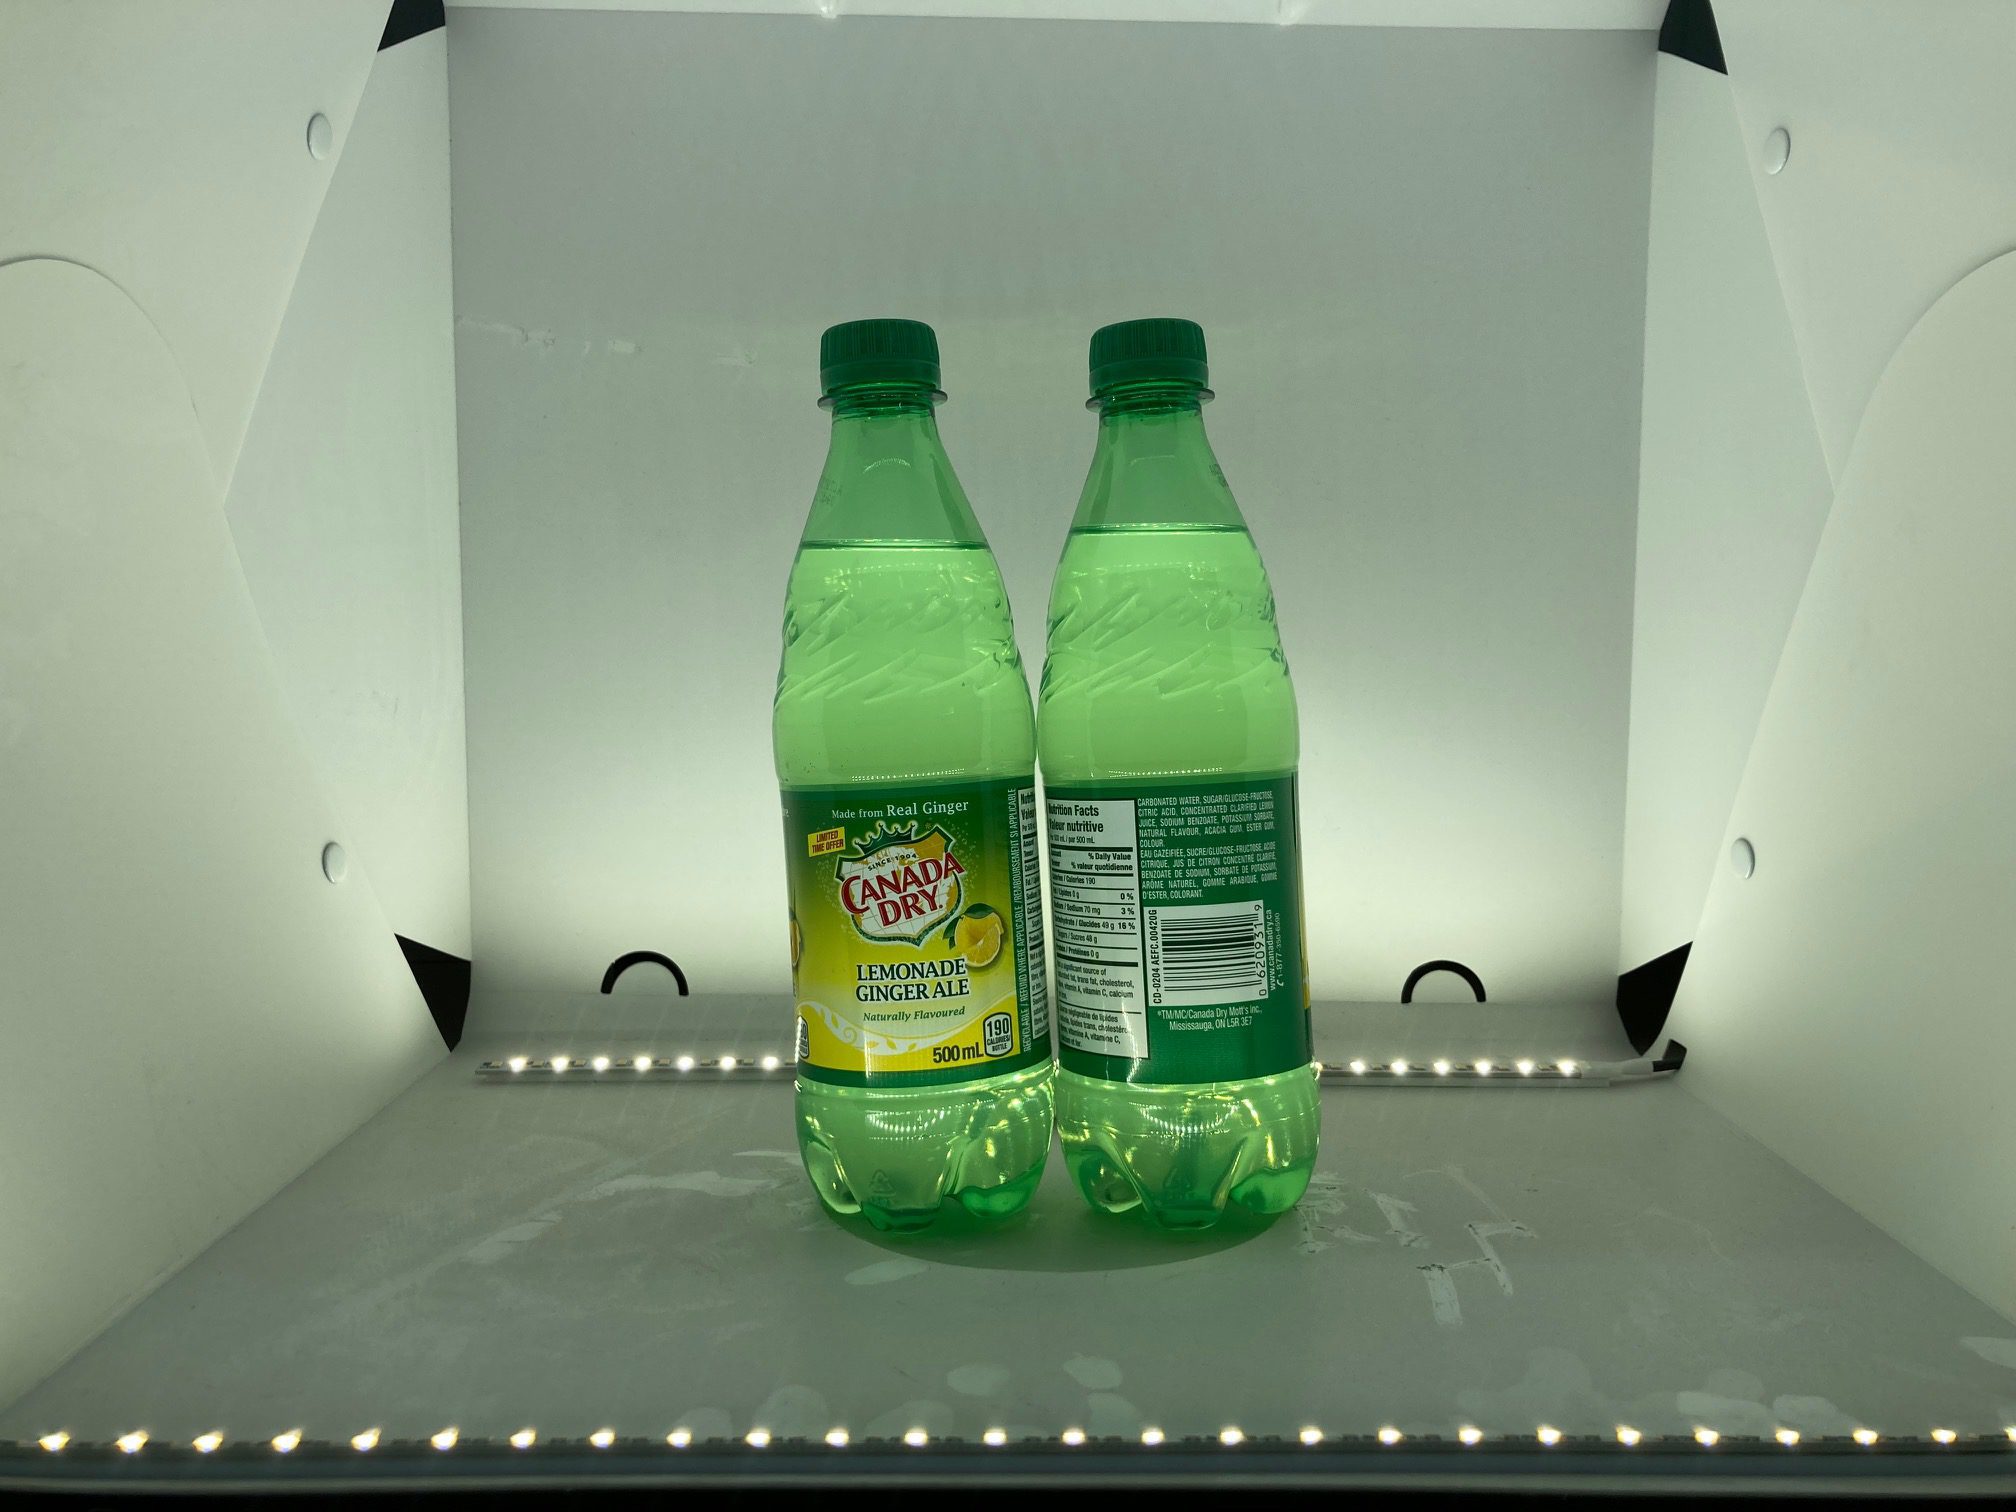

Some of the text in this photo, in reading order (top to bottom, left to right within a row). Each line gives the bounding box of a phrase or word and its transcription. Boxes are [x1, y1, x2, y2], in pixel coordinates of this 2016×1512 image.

[1008, 788, 1018, 828] APPLICABLE
[1138, 798, 1177, 806] CARBONATED
[1138, 808, 1158, 816] CITRIC
[1180, 804, 1228, 815] CONCENTRATED
[1230, 802, 1257, 812] CLARIFIED
[1259, 801, 1274, 810] LEMON
[832, 801, 969, 819] Made from Real Ginger
[1074, 805, 1099, 817] Facts
[1067, 820, 1104, 832] nutritive
[1139, 819, 1158, 828] JUICE,
[1160, 817, 1184, 826] SODIUM
[1222, 813, 1252, 823] POTASSIUM
[816, 830, 838, 843] LIMITED
[1010, 829, 1018, 838] SI
[1139, 828, 1167, 838] NATURAL
[1204, 826, 1226, 835] ACACIA
[1246, 823, 1262, 832] ESTER
[812, 839, 844, 854] TIME OFFER
[1088, 852, 1094, 860] %
[1095, 853, 1111, 861] Daily
[1140, 849, 1152, 858] EAU
[868, 853, 917, 871] SINCE 1904
[1077, 862, 1093, 870] valeur
[1095, 863, 1133, 871] quotidienne
[1173, 859, 1184, 868] JUS
[1188, 858, 1196, 867] DE
[1198, 857, 1220, 866] CITRON
[1142, 870, 1171, 878] BENZOATE
[1174, 869, 1182, 877] DE
[1185, 868, 1211, 877] SODIUM,
[1214, 866, 1239, 876] SORBATE
[1241, 865, 1248, 873] DE
[841, 852, 966, 914] CANADA
[1066, 875, 1084, 884] Calories
[1202, 877, 1226, 887] GOMME
[1067, 904, 1083, 912] Sodium
[1014, 906, 1026, 946] APPLICABLE
[1079, 919, 1100, 928] Glucides
[1128, 922, 1135, 930] %
[1071, 932, 1085, 941] Sucres
[1266, 909, 1276, 990] www.canadadry.ca
[1017, 948, 1028, 973] WHERE
[1149, 909, 1162, 1004] CD-0204 AEFC.00420G
[857, 958, 966, 981] LEMONADE
[1101, 968, 1106, 976] of
[1019, 973, 1029, 1002] REFUND
[1090, 977, 1098, 986] fat,
[1099, 979, 1134, 988] cholesterol,
[856, 978, 969, 1002] GINGER ALE
[1083, 987, 1101, 996] vitamin
[1102, 989, 1108, 997] C,
[1109, 990, 1133, 998] calcium
[863, 1006, 966, 1022] Naturally Flavoured
[1092, 1012, 1098, 1020] de
[1216, 1007, 1228, 1018] Dry
[1228, 1006, 1249, 1016] Mott's
[987, 1018, 1009, 1037] 190
[1021, 1008, 1032, 1052] RECYCLABLE
[1169, 1016, 1253, 1031] Mississauga, ON L5R 3E7
[1114, 1036, 1120, 1044] C,
[933, 1042, 984, 1063] 500 mL
[992, 1043, 1007, 1051] BOTTLE
